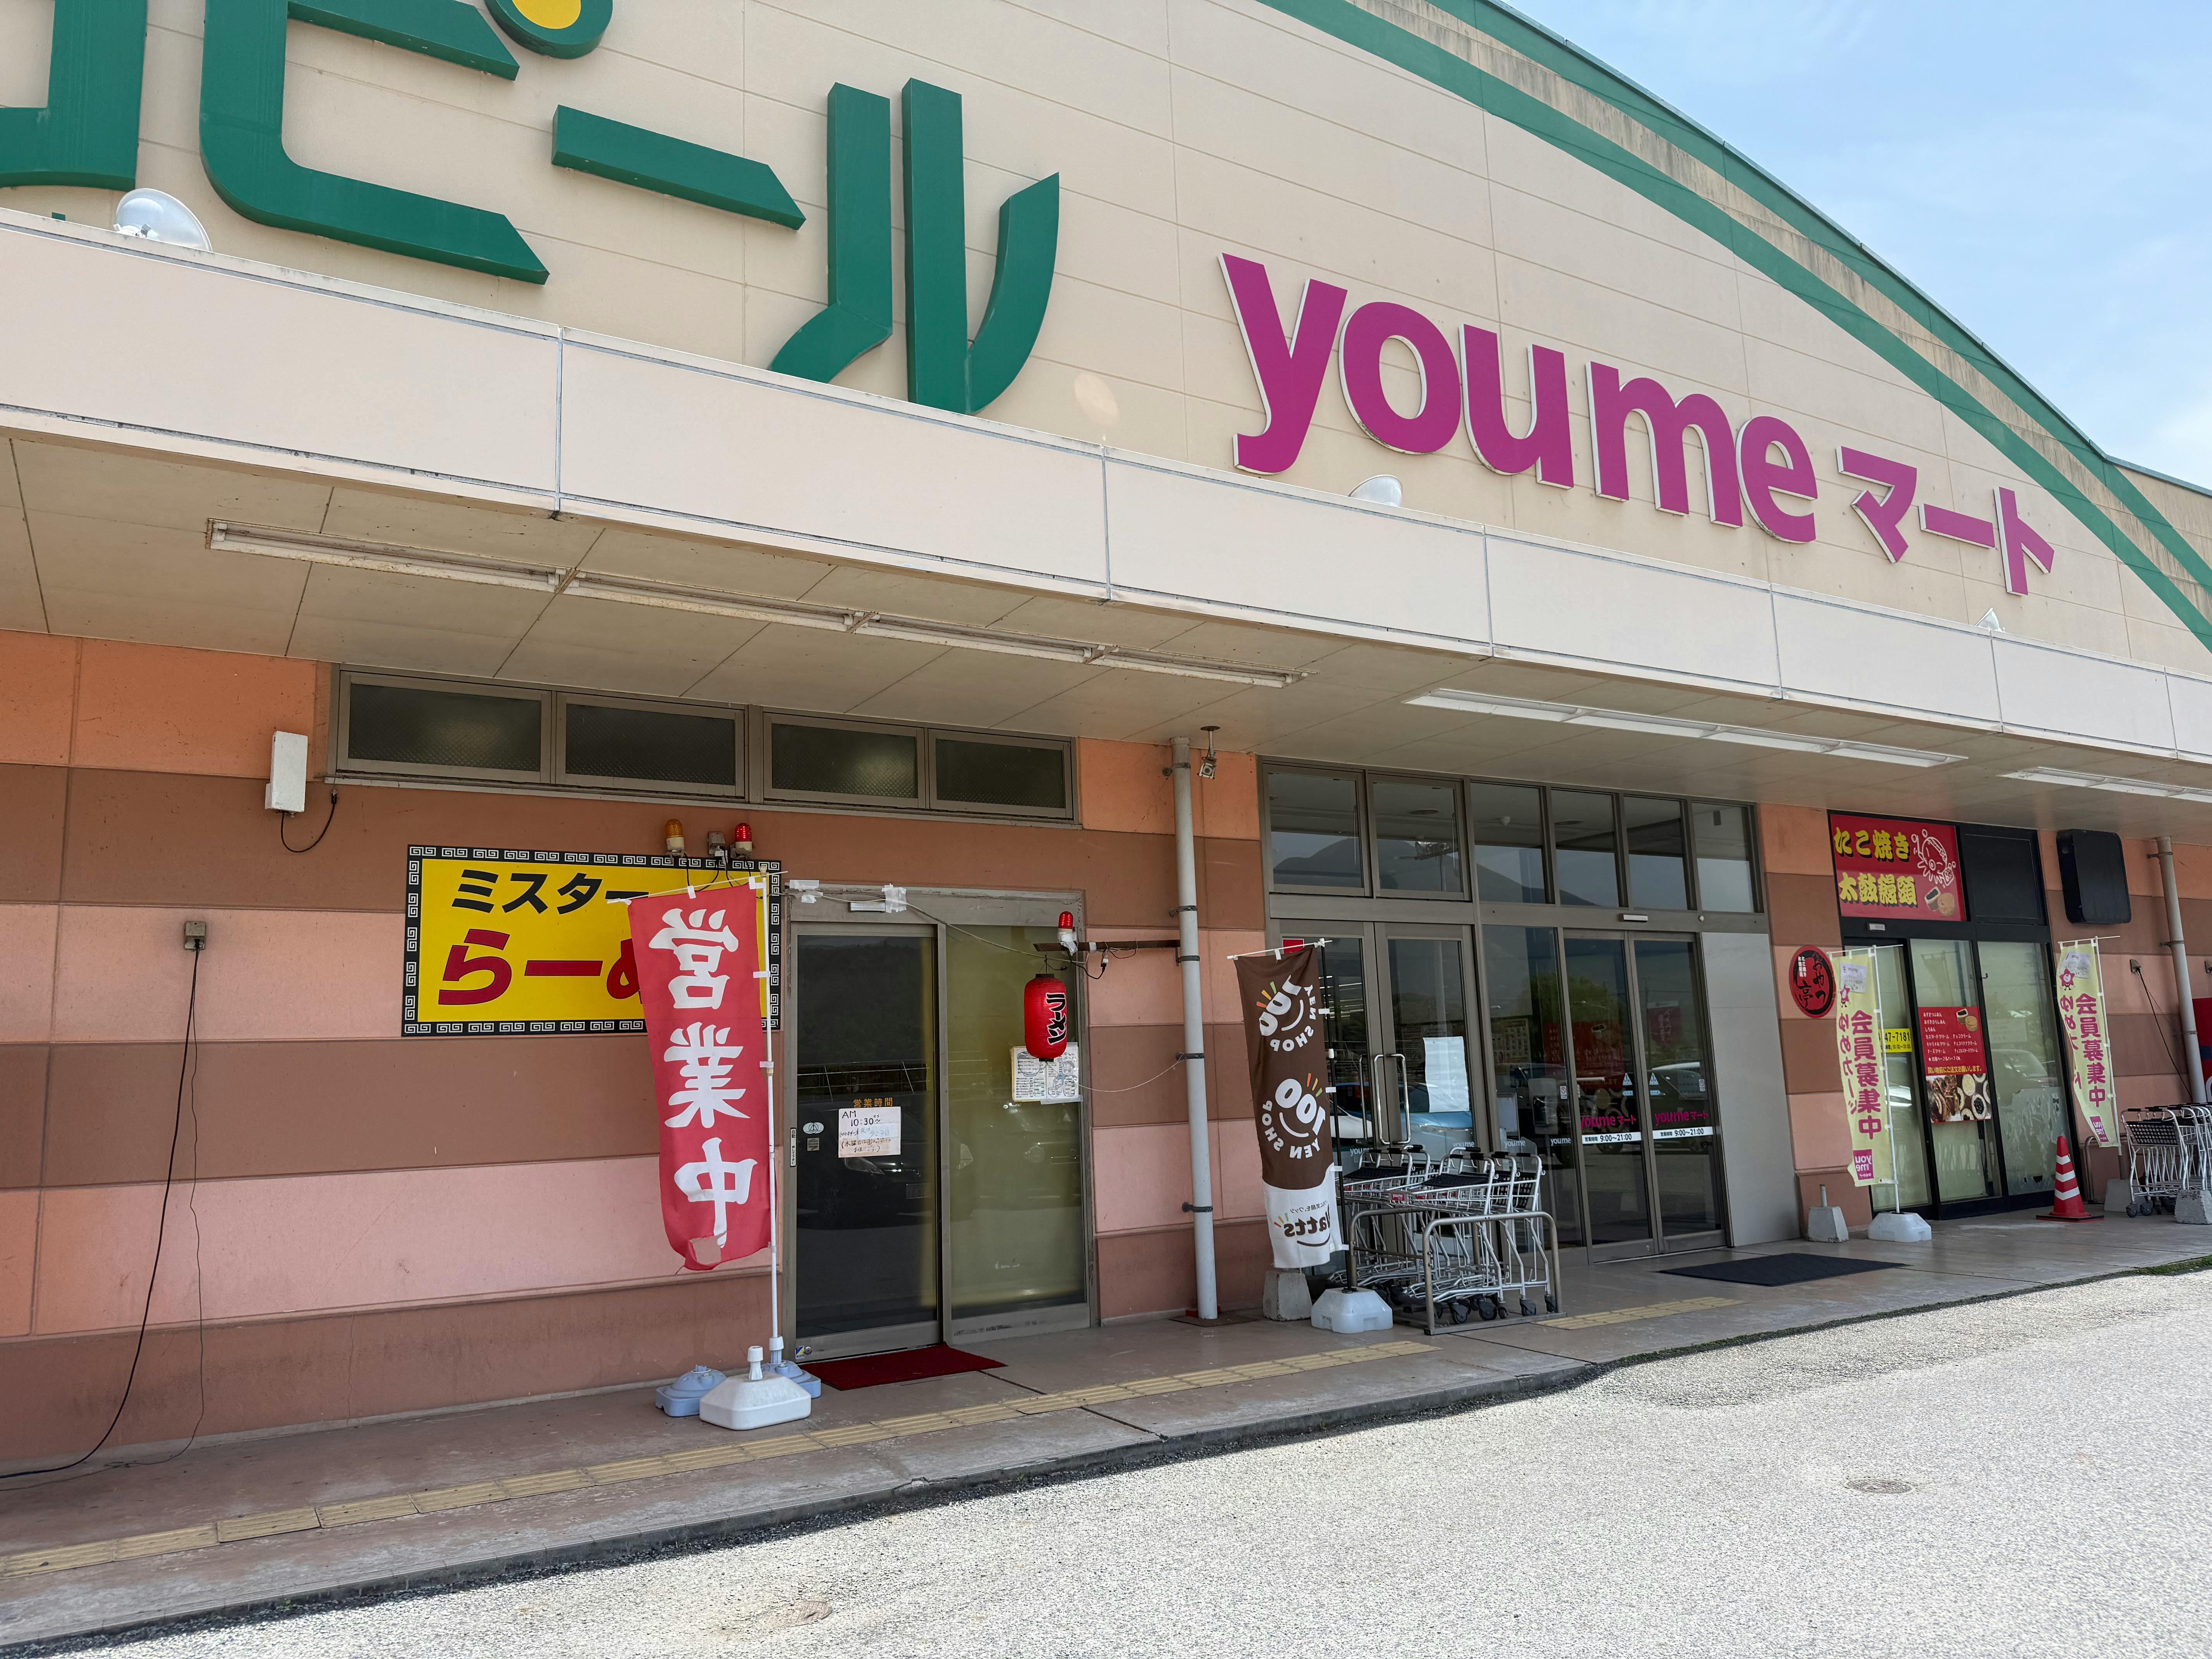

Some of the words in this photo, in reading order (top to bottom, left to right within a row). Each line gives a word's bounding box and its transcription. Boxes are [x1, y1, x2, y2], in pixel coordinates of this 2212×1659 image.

[0, 0, 1059, 414] ピール
[1218, 252, 1817, 543] youme
[1836, 445, 2055, 596] マート
[1834, 827, 1911, 862] たこ焼き
[451, 869, 649, 914] ミスター
[1046, 993, 1066, 1045] ラーメン
[649, 908, 758, 1249] 営業中
[853, 1097, 893, 1108] 営業時間
[842, 1110, 857, 1118] AM
[1654, 1111, 1690, 1126] youme
[1690, 1110, 1709, 1120] マート
[1580, 1115, 1616, 1130] youme
[1617, 1115, 1637, 1125] マート
[1504, 1140, 1526, 1149] youme
[1551, 1137, 1571, 1146] youme
[1350, 1147, 1374, 1157] you
